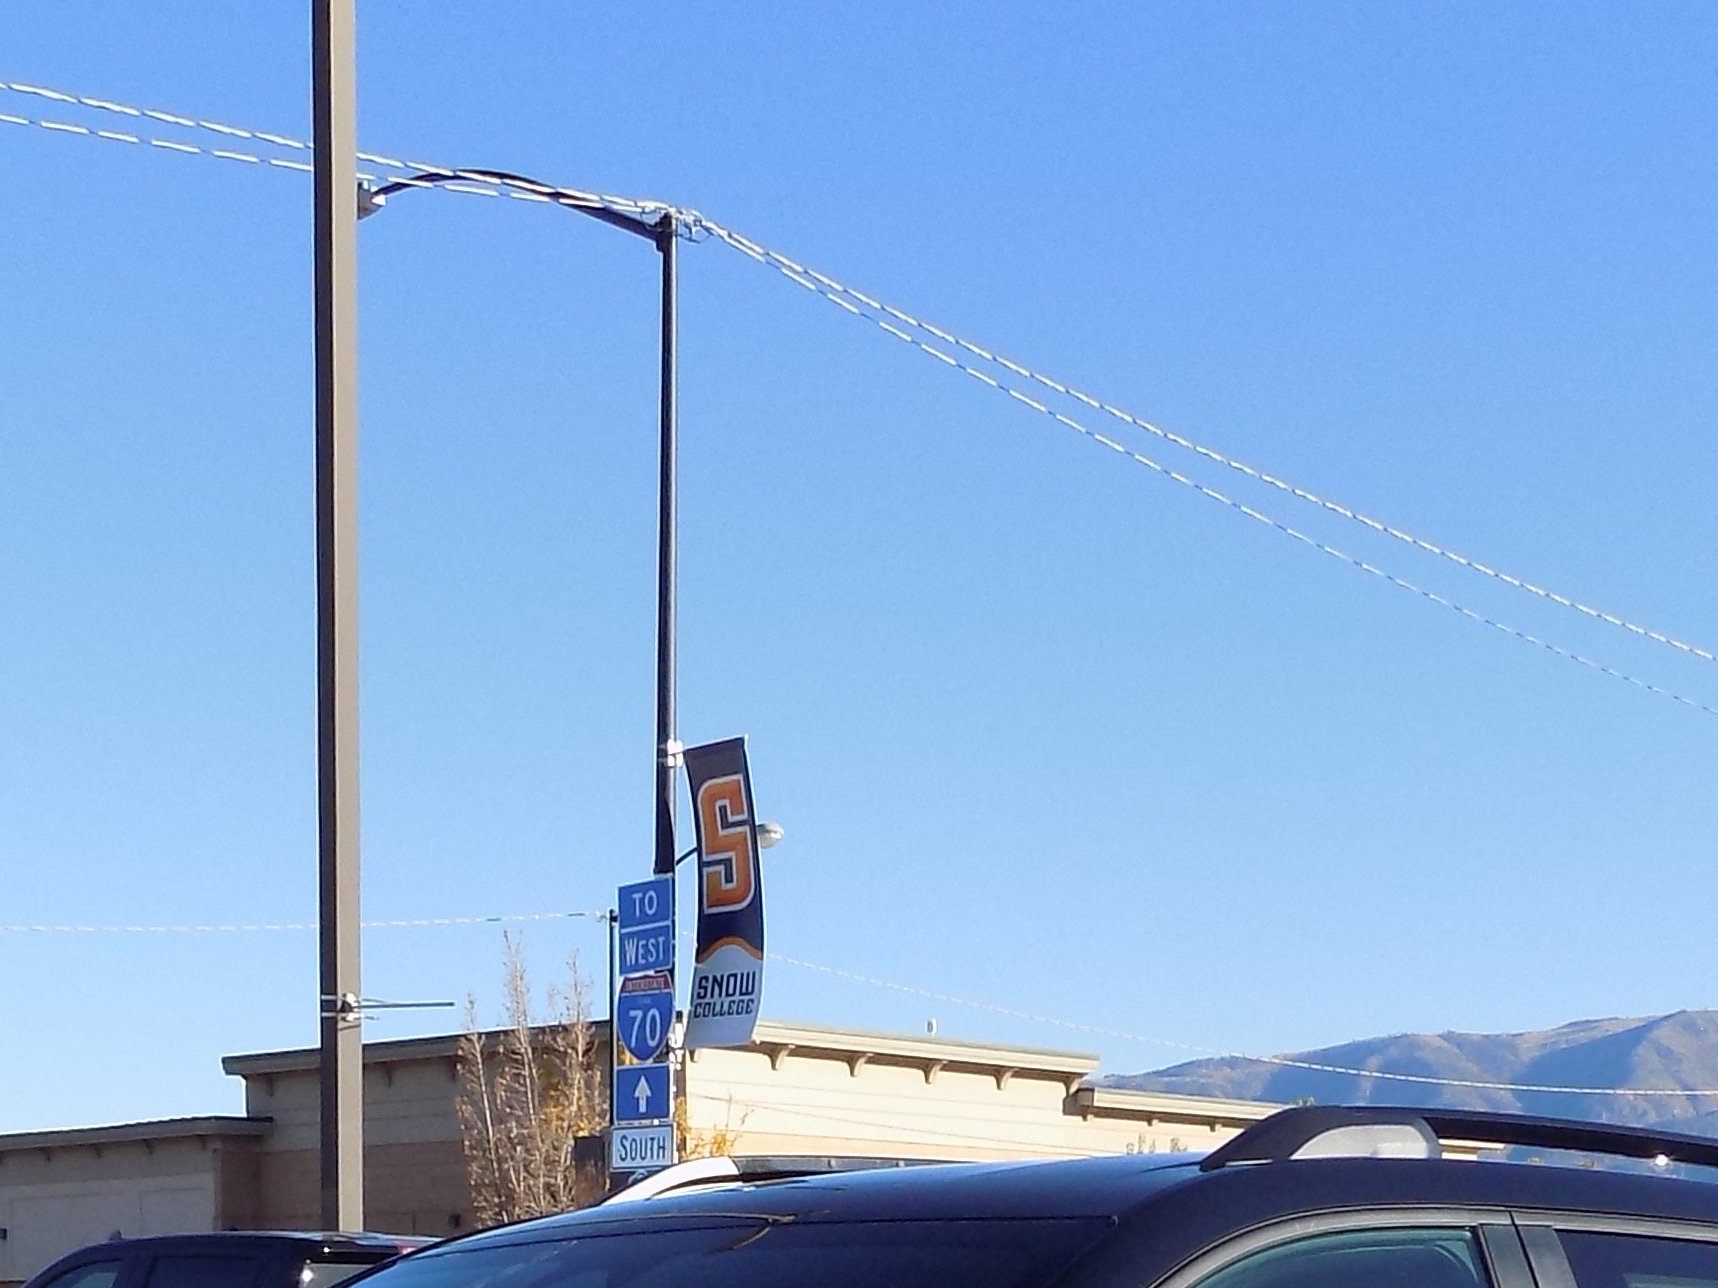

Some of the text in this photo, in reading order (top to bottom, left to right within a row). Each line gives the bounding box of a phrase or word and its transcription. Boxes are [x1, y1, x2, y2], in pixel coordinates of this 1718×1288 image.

[697, 774, 755, 914] S
[632, 890, 658, 918] TO
[623, 935, 666, 968] WEST
[696, 970, 756, 1000] SNOW
[694, 998, 755, 1019] COLLEGE
[629, 1008, 661, 1048] 70
[619, 1135, 666, 1161] SOUTH
